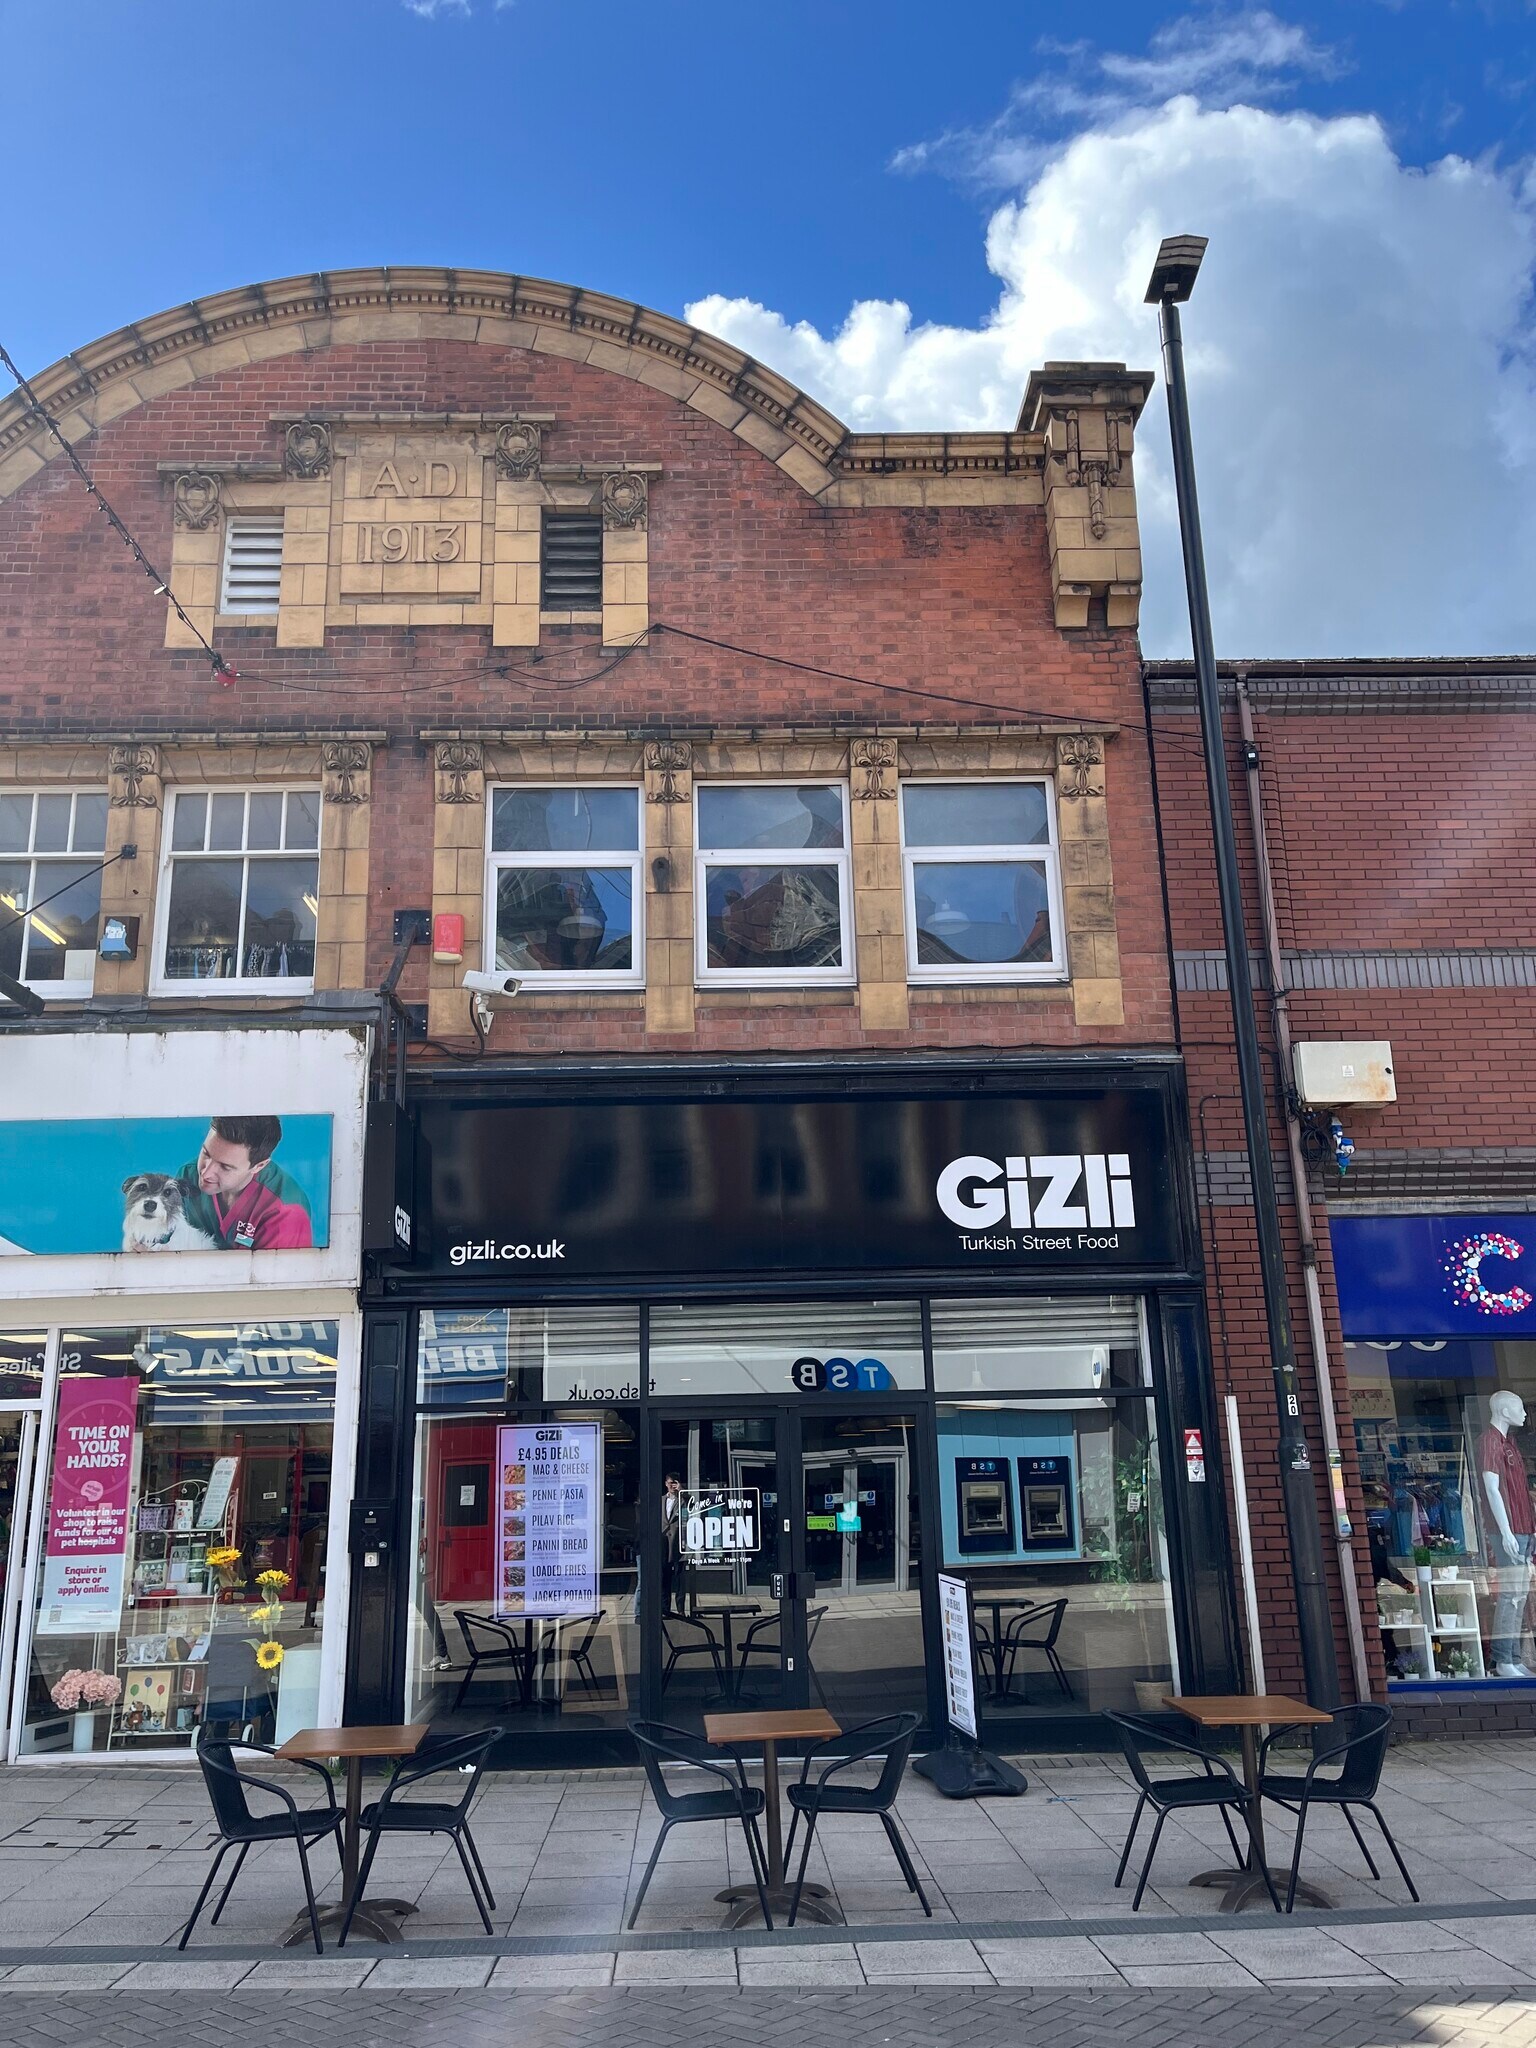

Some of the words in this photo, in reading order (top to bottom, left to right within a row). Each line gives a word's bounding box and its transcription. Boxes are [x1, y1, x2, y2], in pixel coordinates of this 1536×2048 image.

[361, 524, 461, 563] 1913
[958, 1235, 1017, 1250] Turkish
[1022, 1234, 1072, 1250] Street
[1077, 1233, 1119, 1249] Food
[449, 1238, 566, 1266] gizli.co.uk
[68, 1426, 107, 1440] TIME
[109, 1424, 130, 1439] ON
[78, 1440, 119, 1454] YOUR
[518, 1447, 547, 1461] £4.95
[550, 1446, 580, 1460] DEALS
[66, 1453, 127, 1468] HANDS?
[532, 1464, 550, 1475] MAC
[553, 1464, 558, 1475] &
[561, 1463, 590, 1474] CHEESE
[532, 1489, 557, 1500] PENNE
[560, 1488, 584, 1499] PASTA
[687, 1496, 712, 1514] Come
[714, 1491, 723, 1504] in
[728, 1498, 752, 1509] We're
[56, 1508, 100, 1518] Volunteer
[101, 1507, 109, 1515] in
[111, 1508, 125, 1516] our
[63, 1518, 85, 1528] shop
[86, 1518, 97, 1527] to
[97, 1517, 118, 1526] raise
[532, 1515, 555, 1526] PILAV
[557, 1514, 575, 1525] RICE
[54, 1528, 80, 1537] funds
[81, 1527, 95, 1536] for
[112, 1526, 123, 1535] 48
[686, 1515, 754, 1550] OPEN
[61, 1538, 76, 1548] pet
[78, 1536, 116, 1547] hospitals
[532, 1539, 560, 1551] PANINI
[562, 1538, 588, 1550] BREAD
[64, 1565, 97, 1576] Enquire
[99, 1565, 106, 1573] in
[532, 1565, 562, 1577] LOADED
[564, 1564, 587, 1576] FRIES
[68, 1576, 90, 1584] store
[57, 1586, 82, 1596] apply
[83, 1584, 109, 1594] online
[532, 1590, 561, 1602] JACKET
[564, 1589, 592, 1601] POTATO
